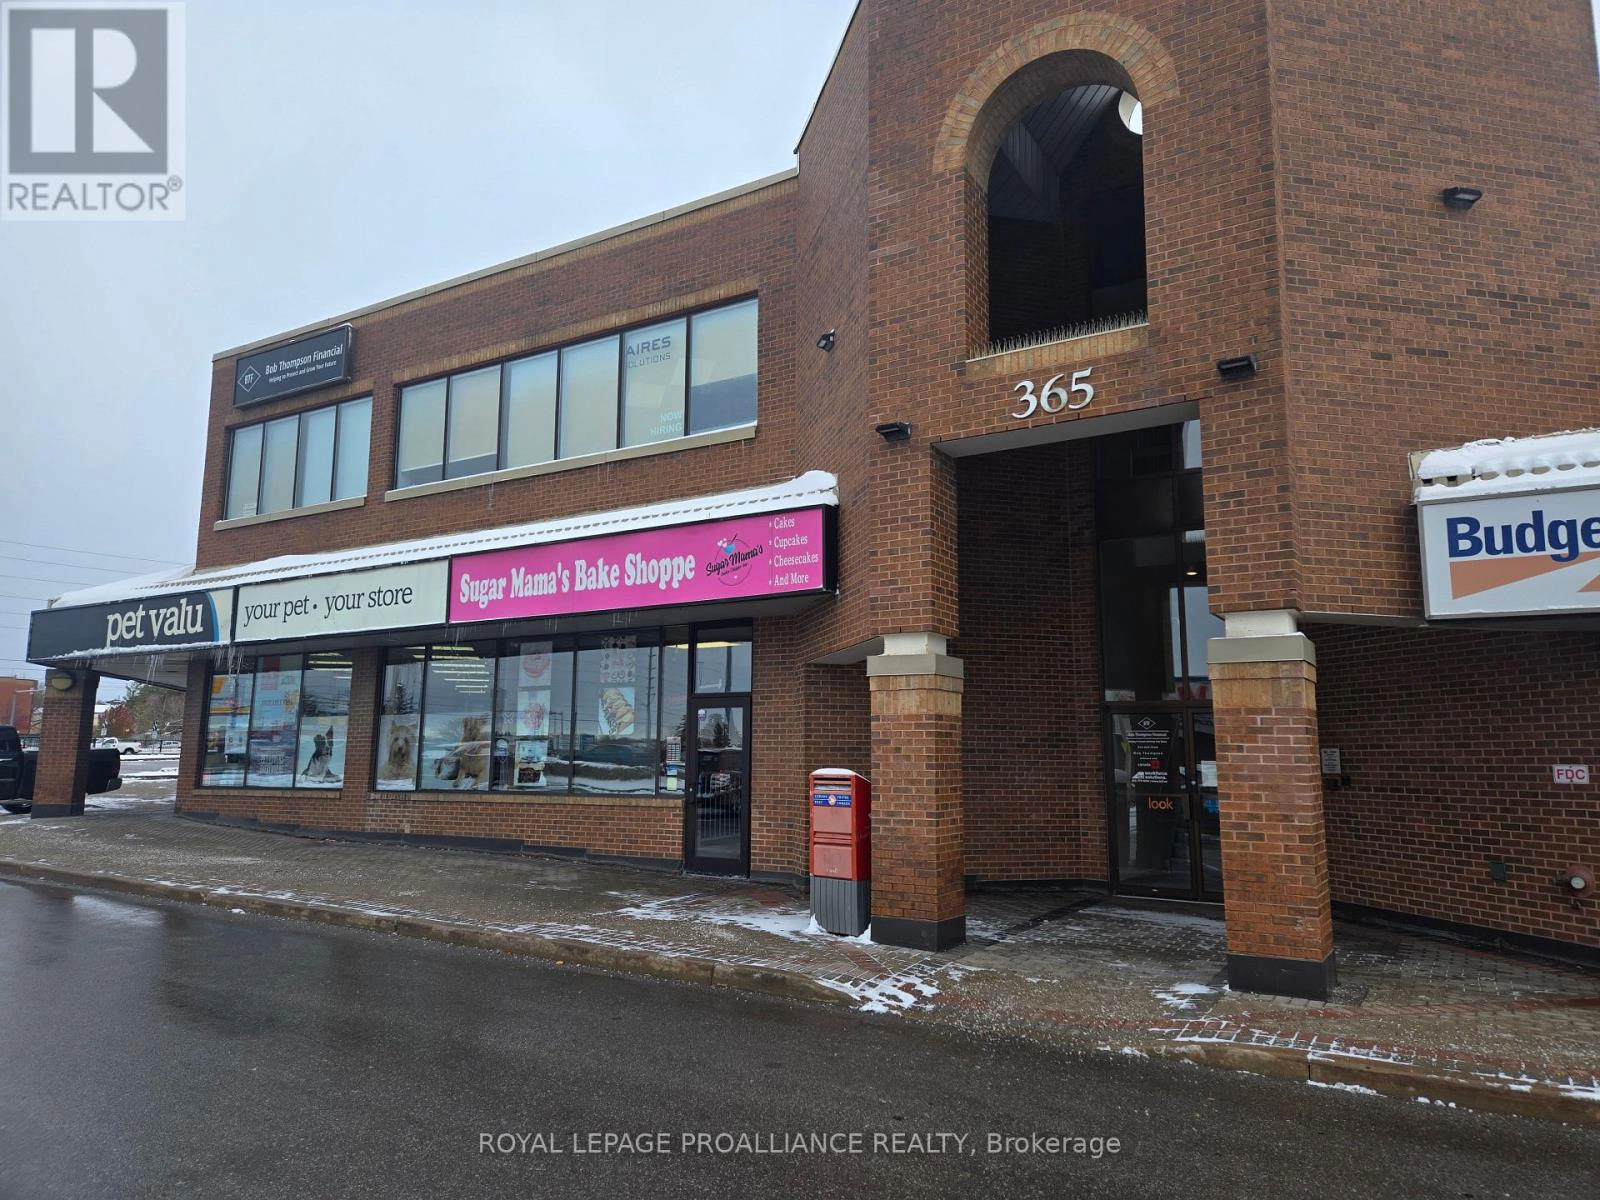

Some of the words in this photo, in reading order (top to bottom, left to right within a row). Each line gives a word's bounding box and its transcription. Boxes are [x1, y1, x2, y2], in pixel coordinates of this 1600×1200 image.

[626, 335, 671, 357] AIRES
[265, 362, 278, 375] Bob
[279, 354, 312, 372] Thompson
[313, 343, 343, 361] Financial
[1012, 367, 1094, 419] 365
[660, 408, 683, 424] NOW
[649, 422, 682, 437] HIRING
[774, 517, 795, 529] Cakes
[774, 534, 808, 549] Cupcakes
[706, 557, 729, 577] Sugar
[728, 544, 764, 567] Mama's
[774, 552, 819, 567] Cheesecakes
[460, 573, 506, 609] Sugar
[510, 562, 570, 598] Mama's
[574, 558, 620, 591] Bake
[625, 552, 696, 590] Shoppe
[774, 575, 789, 586] And
[790, 572, 809, 584] More
[244, 602, 280, 627] your
[283, 595, 310, 623] pet
[324, 592, 365, 619] your
[367, 586, 413, 608] store
[107, 604, 146, 649] pet
[148, 598, 204, 637] valu
[1557, 768, 1586, 780] FDC
[1148, 796, 1174, 810] look
